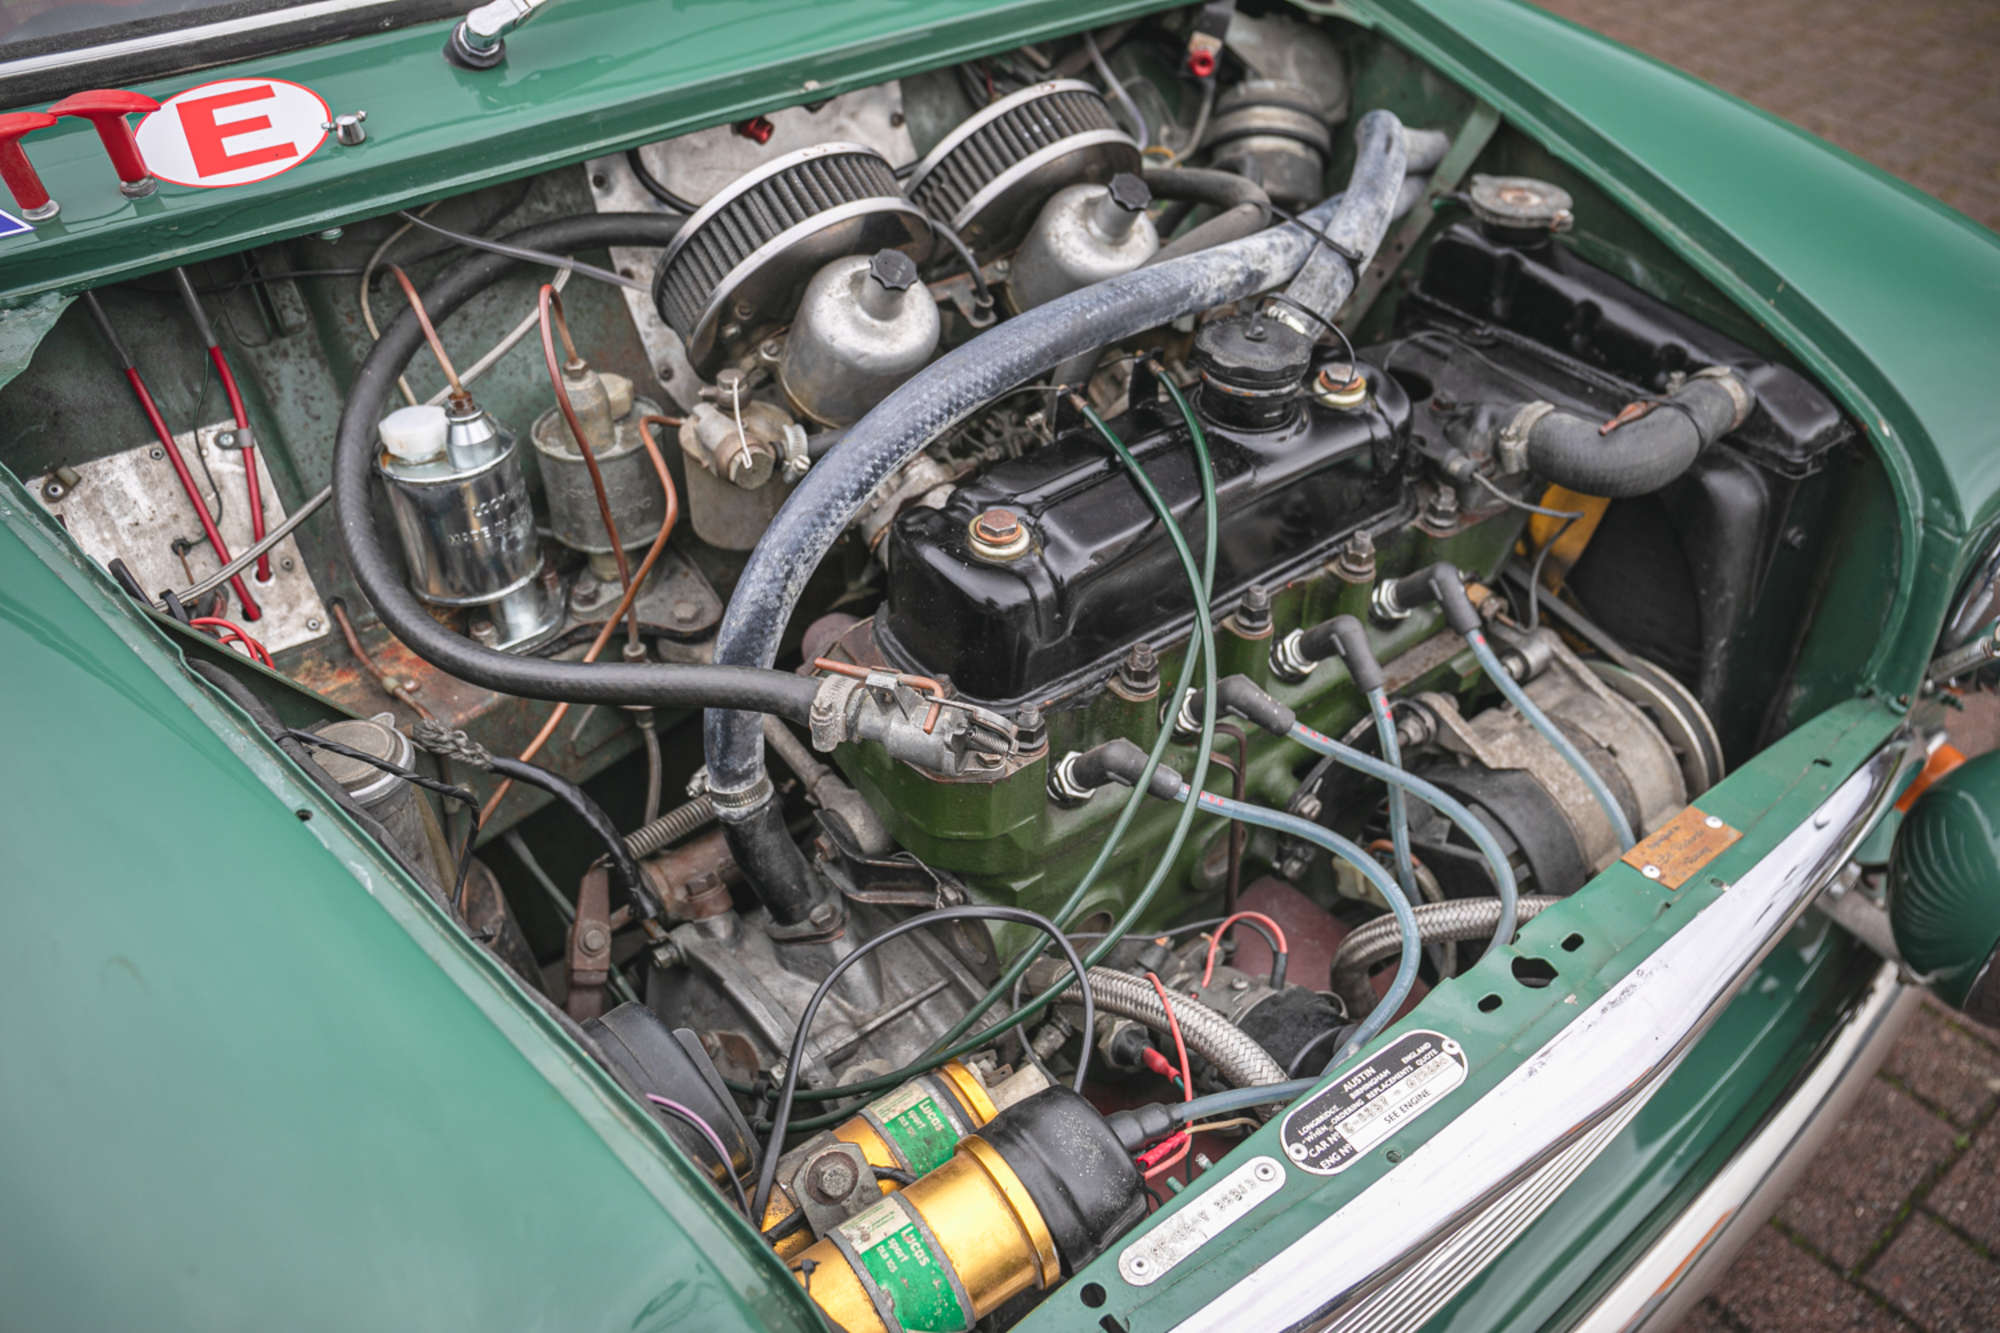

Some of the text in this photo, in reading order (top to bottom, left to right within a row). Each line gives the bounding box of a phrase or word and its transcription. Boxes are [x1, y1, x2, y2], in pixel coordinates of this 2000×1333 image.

[176, 84, 299, 178] E
[1329, 1098, 1364, 1125] ORDERING
[1366, 1064, 1413, 1100] REPLACEMENTS
[1415, 1047, 1437, 1066] QUOTE
[1342, 1065, 1376, 1092] AUSTIN
[1349, 1068, 1390, 1099] BIRMINGHAM
[1401, 1040, 1431, 1064] ENGLAND
[919, 1099, 944, 1131] Lucas
[1320, 1152, 1341, 1169] ENG
[1383, 1110, 1399, 1124] SEE
[1398, 1088, 1430, 1113] ENGINE
[1307, 1139, 1330, 1158] CAR
[888, 1238, 909, 1262] sport
[901, 1225, 930, 1266] Lucas
